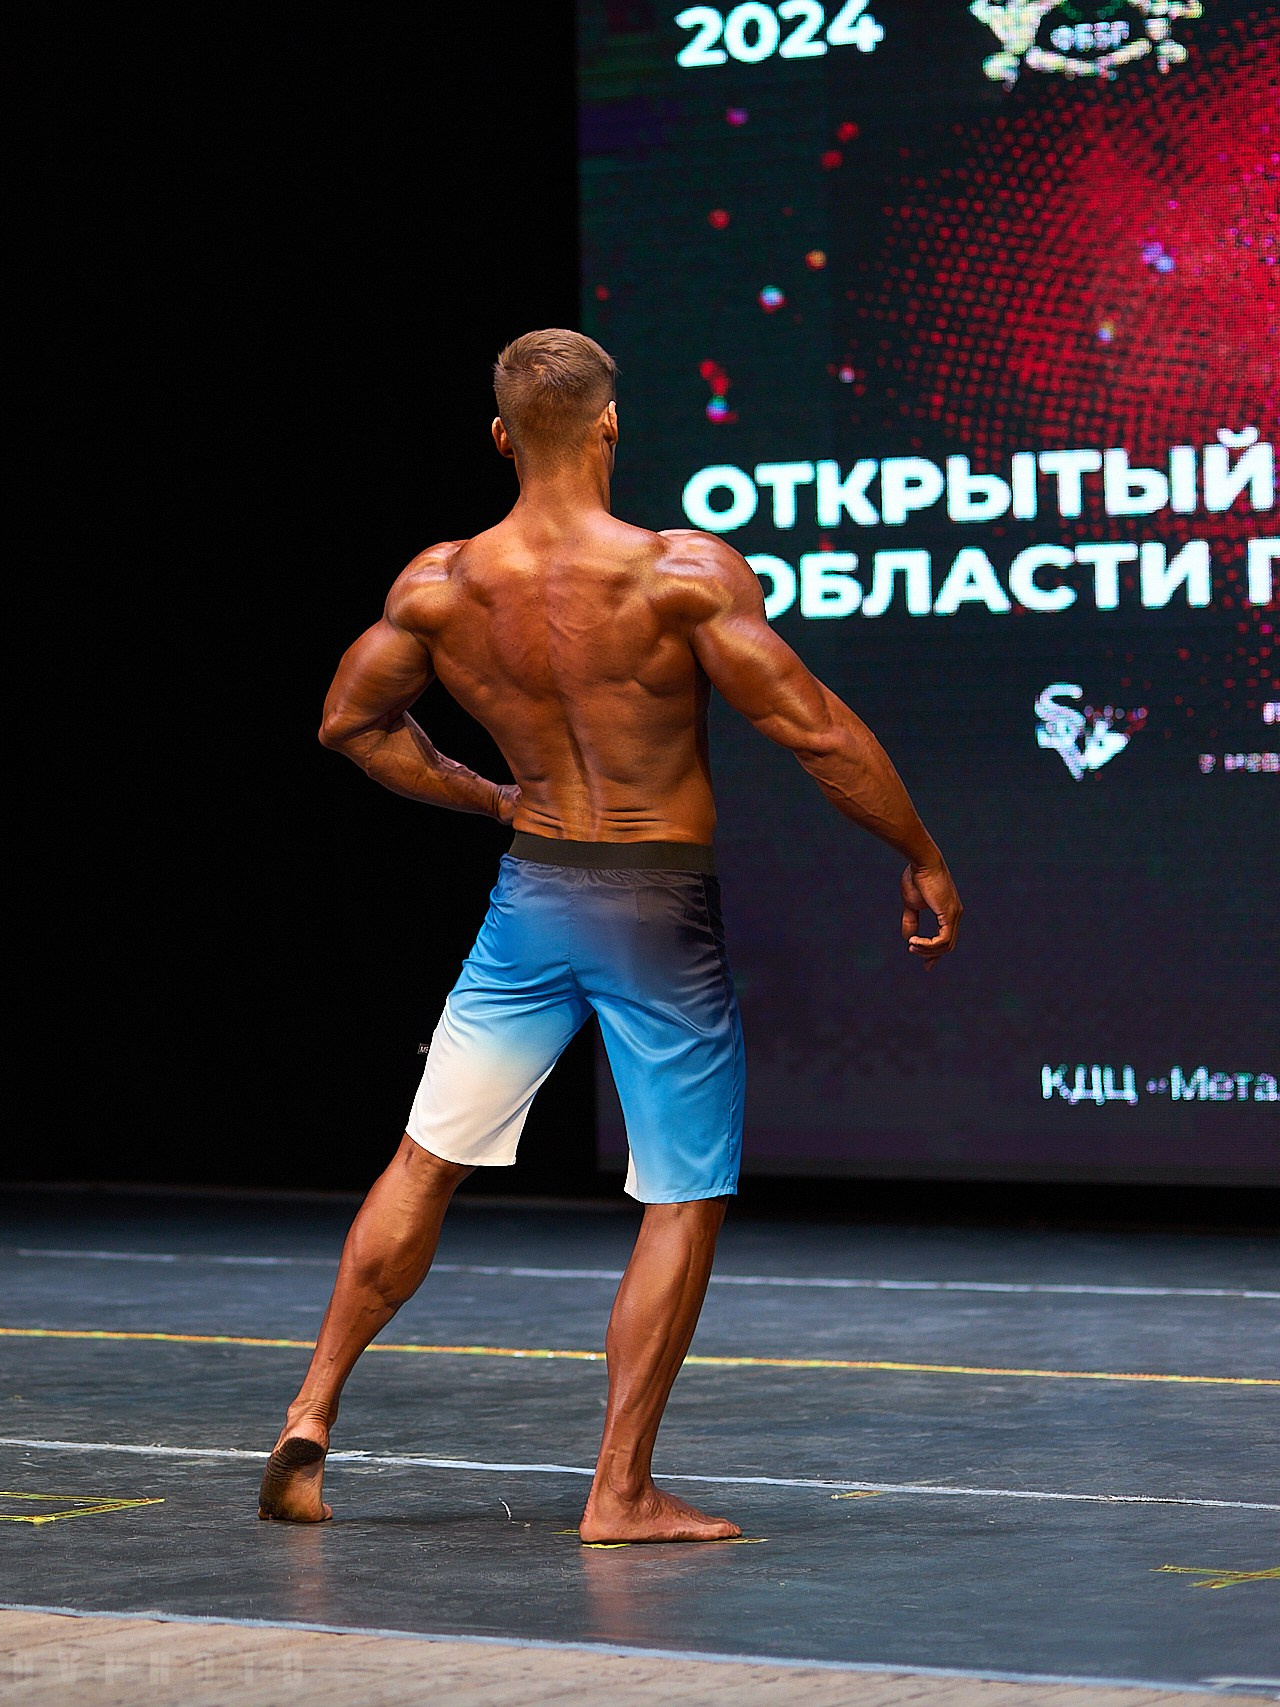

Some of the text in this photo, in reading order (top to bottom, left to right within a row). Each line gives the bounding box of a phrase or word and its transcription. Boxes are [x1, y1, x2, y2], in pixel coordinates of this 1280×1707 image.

[674, 0, 886, 68] 2024
[681, 427, 1275, 533] ОТКРЫТЫЙ
[1041, 1063, 1138, 1106] КДЦ
